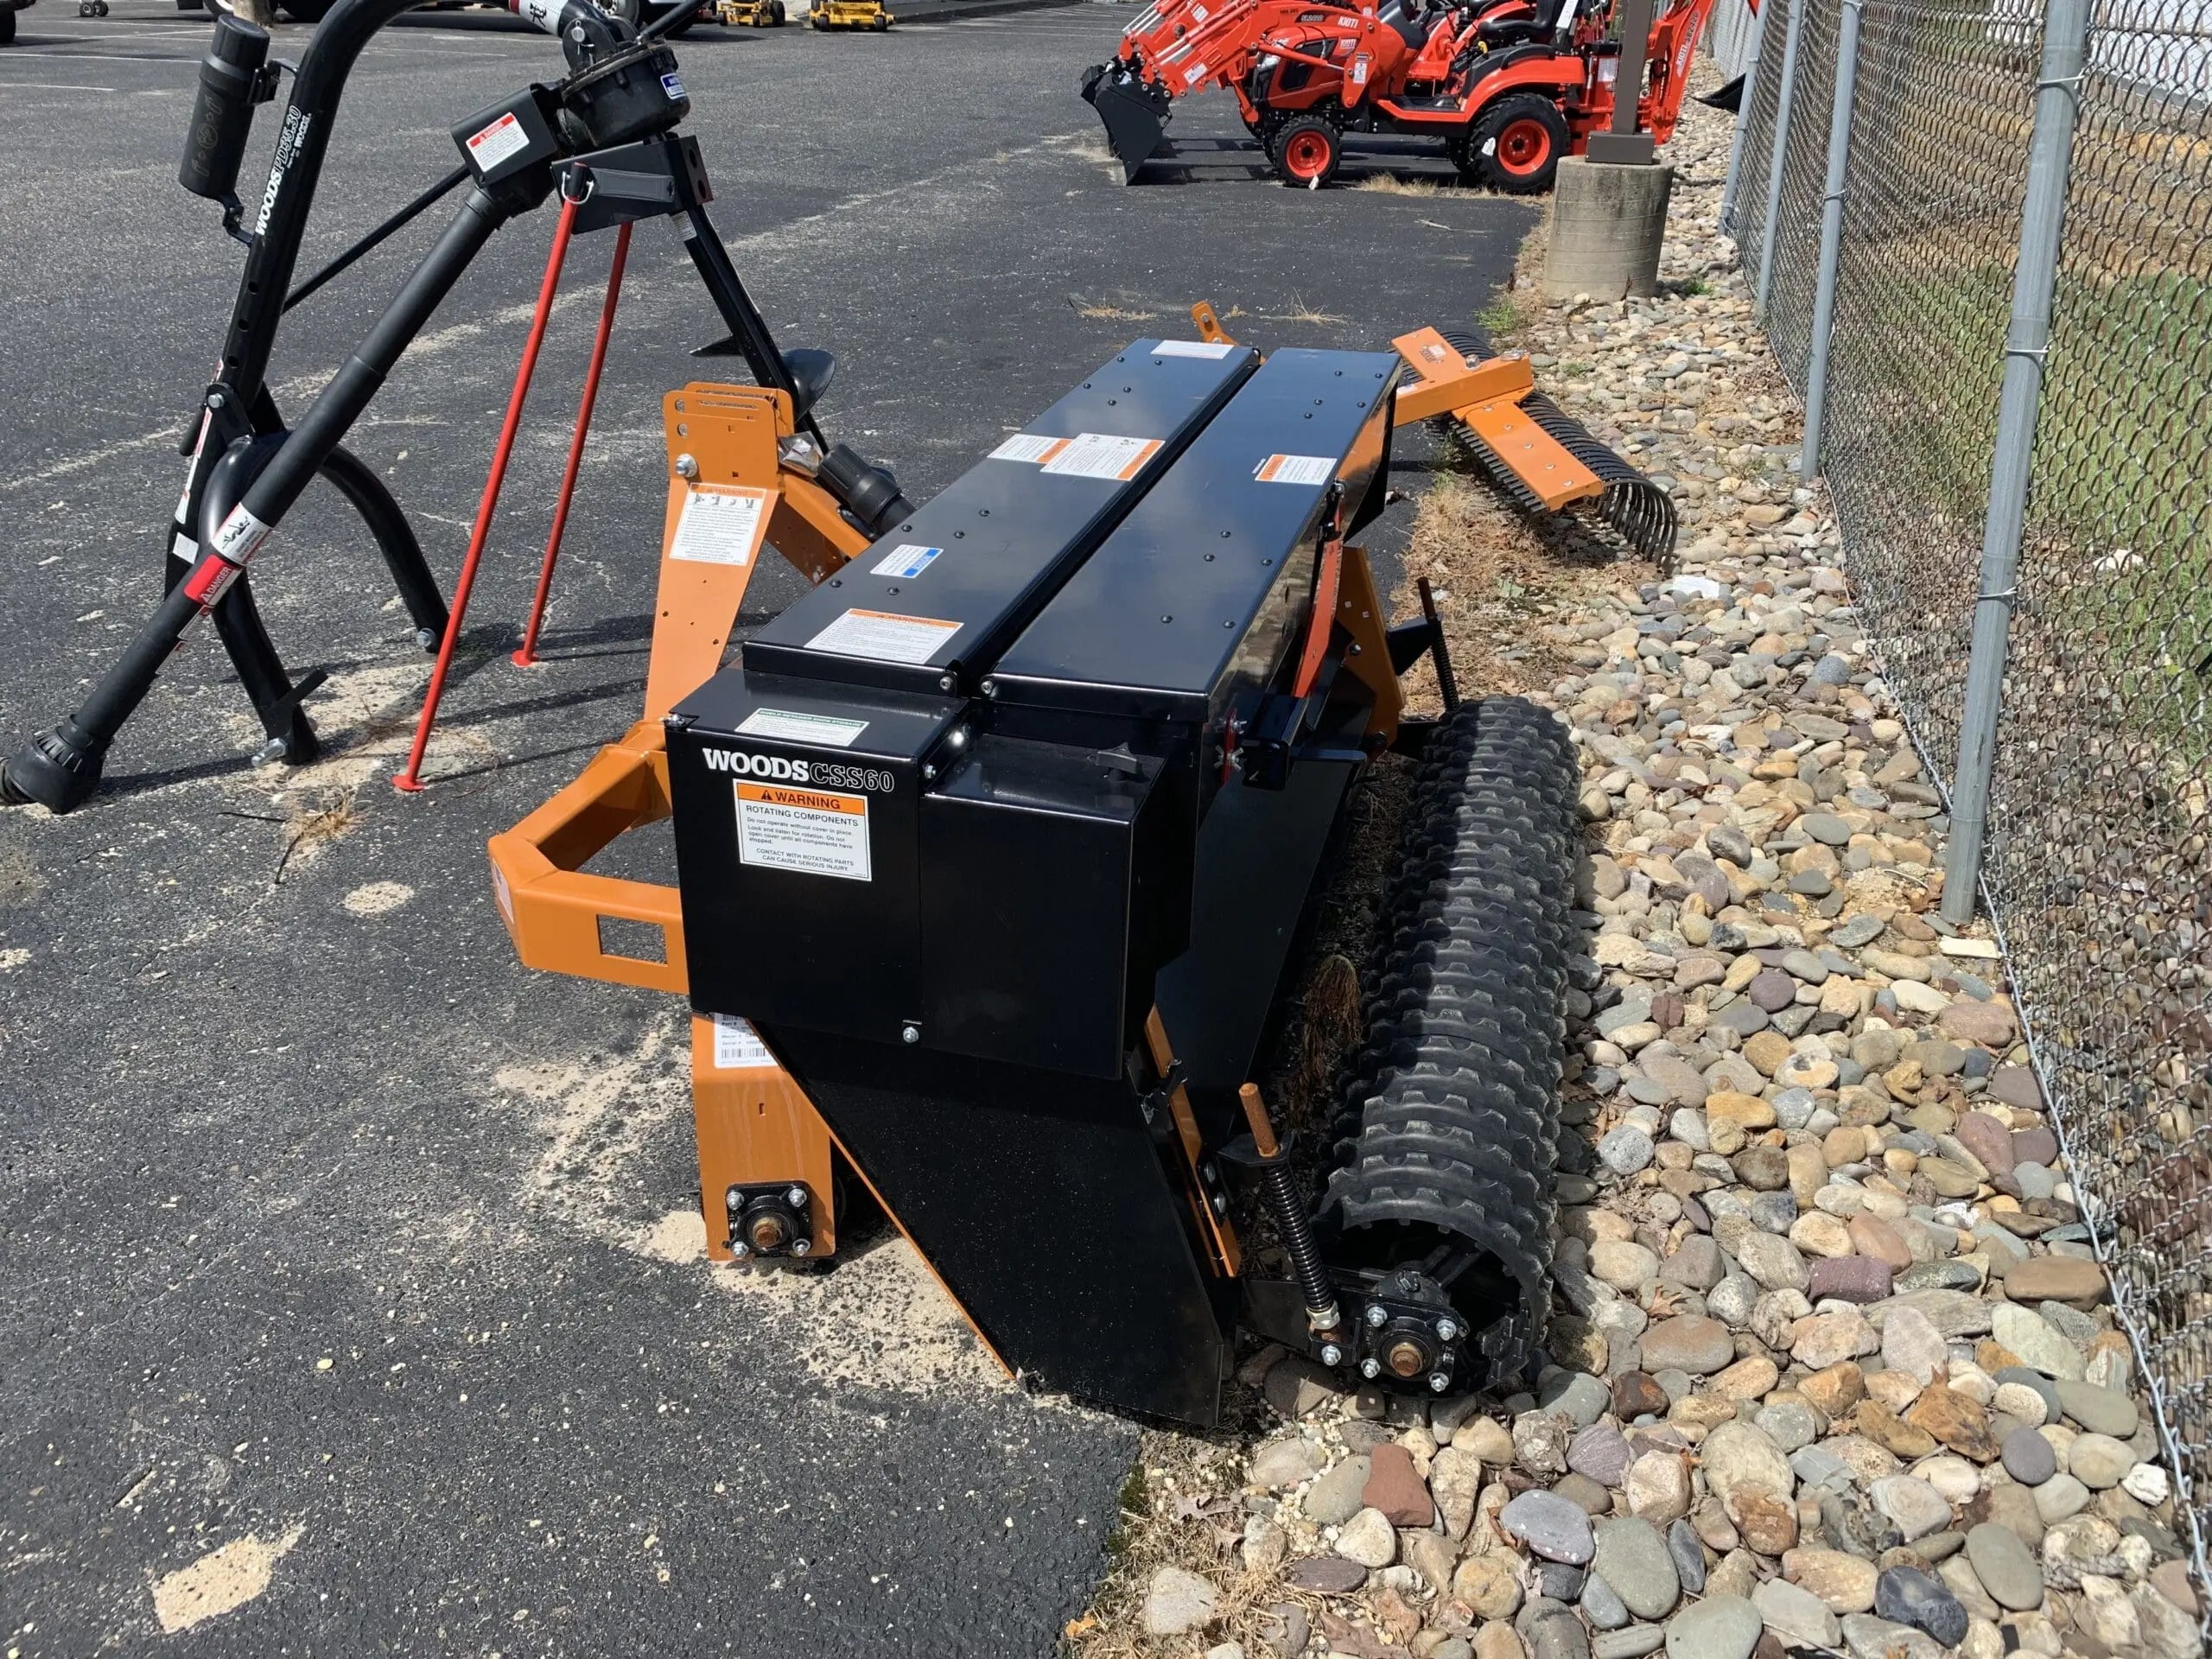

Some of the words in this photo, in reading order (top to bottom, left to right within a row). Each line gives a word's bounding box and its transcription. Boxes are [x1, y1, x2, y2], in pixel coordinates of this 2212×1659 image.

[1338, 16, 1359, 29] KIOTI
[1675, 44, 1688, 66] KIOTI
[255, 166, 284, 236] WOODS
[206, 566, 232, 594] DANGER
[702, 747, 810, 782] WOODS
[810, 763, 894, 792] CSS60
[775, 791, 841, 810] WARNING
[746, 804, 791, 817] ROTATING
[793, 810, 859, 827] COMPONENTS
[803, 837, 838, 848] components
[756, 848, 785, 857] CONTACT
[803, 854, 833, 863] ROTATING
[834, 858, 855, 867] PARTS
[776, 856, 798, 865] CAUSE
[798, 859, 825, 868] SERIOUS
